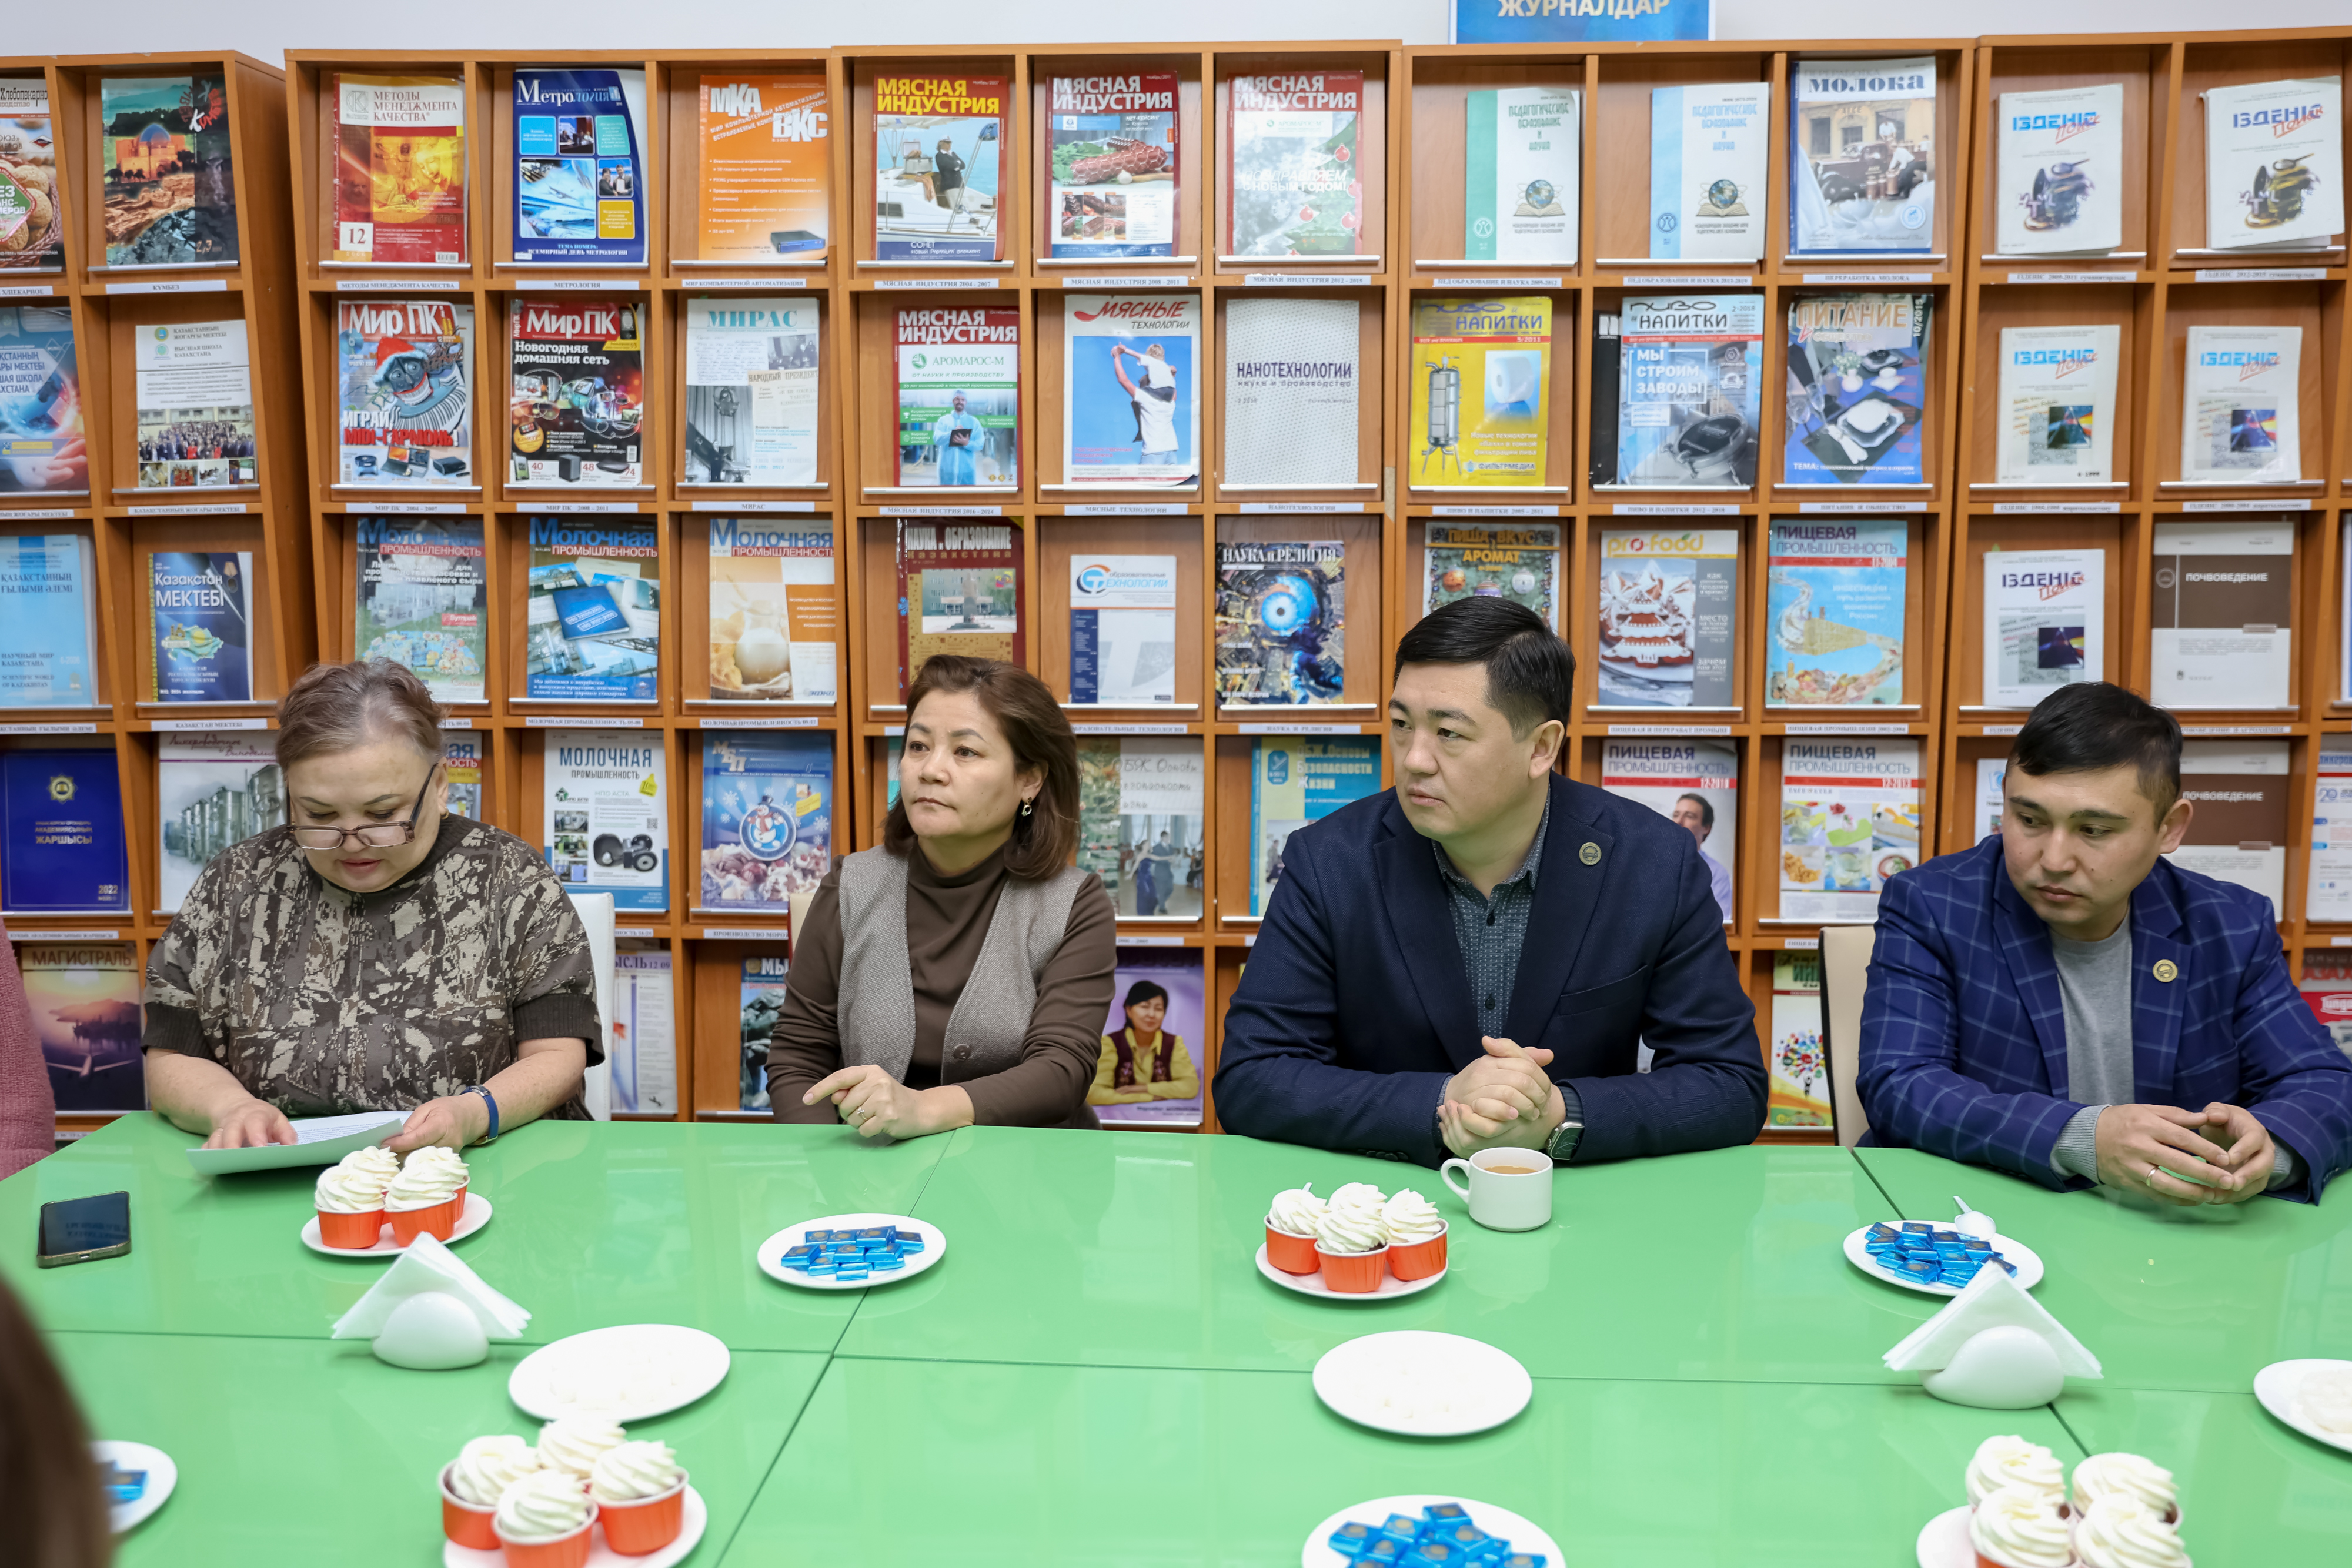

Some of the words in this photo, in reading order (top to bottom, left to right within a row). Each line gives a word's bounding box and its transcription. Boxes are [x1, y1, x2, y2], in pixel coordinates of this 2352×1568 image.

[1498, 0, 1669, 19] ЖУРНАЛДАР
[877, 79, 967, 96] МЯСНАЯ
[1053, 76, 1141, 93] МЯСНАЯ
[1235, 76, 1324, 92] МЯСНАЯ
[375, 91, 420, 101] МЕТОДЫ
[710, 83, 763, 117] МКА
[1053, 92, 1173, 113] ИНДУСТРИЯ
[1235, 92, 1357, 112] ИНДУСТРИЯ
[375, 101, 457, 112] МЕНЕДЖМЕНТА
[710, 125, 723, 133] МИР
[725, 108, 773, 128] КОМПЬЮТЕРНОЙ
[775, 91, 825, 112] АВТОМАТИЗАЦИИ
[877, 95, 999, 115] ИНДУСТРИЯ
[773, 109, 828, 142] ВКС
[1244, 170, 1347, 182] ПОЗДРАВЛЯЕМ
[1242, 182, 1252, 192] С
[1254, 182, 1299, 192] НОВЫМ
[1301, 182, 1347, 192] ГОДОМ!
[348, 228, 366, 245] 12
[1097, 300, 1190, 320] МЯСНЫЕ
[1796, 302, 1909, 329] ПИТАНИЕ
[350, 305, 404, 338] Мир
[410, 304, 443, 335] ПК
[526, 309, 582, 339] Мир
[584, 311, 616, 335] ПК
[707, 310, 798, 328] МИРАС
[899, 310, 985, 326] МЯСНАЯ
[1131, 320, 1190, 330] ТЕХНОЛОГИИ
[1456, 316, 1542, 330] НАПИТКИ
[1639, 314, 1727, 329] НАПИТКИ
[899, 326, 1017, 345] ИНДУСТРИЯ
[514, 340, 589, 354] Новогодняя
[514, 355, 580, 365] домашняя
[583, 356, 610, 365] сеть
[933, 357, 1004, 366] АРОМАРОС-М
[1636, 349, 1664, 362] МЫ
[14, 362, 45, 371] МЕКТЕБІ
[1237, 362, 1352, 379] НАНОТЕХНОЛОГИИ
[1636, 365, 1699, 377] СТРОИМ
[16, 373, 43, 383] ШКОЛА
[749, 372, 781, 382] НАРОДНЫЙ
[1636, 383, 1702, 395] ЗАВОДЫ
[532, 462, 543, 470] 40
[530, 517, 655, 547] Молочная
[710, 519, 833, 548] Молочная
[907, 527, 937, 550] НАУКА
[945, 526, 1012, 550] ОБРАЗОВАНИЕ
[1776, 526, 1856, 541] ПИЩЕВАЯ
[381, 545, 482, 556] ПРОМЫШЛЕННОСТЬ
[552, 545, 658, 557] ПРОМЫШЛЕННОСТЬ
[1776, 541, 1898, 554] ПРОМЫШЛЕННОСТЬ
[1222, 549, 1264, 563] НАУКА
[1267, 552, 1274, 563] и
[1277, 549, 1337, 563] РЕЛИГИЯ
[1462, 550, 1521, 563] АРОМАТ
[155, 571, 223, 586] Қазақстан
[2002, 571, 2083, 588] ІЗДЕНІС
[2186, 572, 2269, 584] ПОЧВОВЕДЕНИЕ
[155, 589, 225, 607] МЕКТЕБІ
[559, 747, 652, 768] МОЛОЧНАЯ
[713, 740, 747, 772] МБП
[1609, 744, 1695, 762] ПИЩЕВАЯ
[1790, 744, 1876, 761] ПИЩЕВАЯ
[1608, 760, 1729, 774] ПРОМЫШЛЕННОСТЬ
[1789, 760, 1910, 775] ПРОМЫШЛЕННОСТЬ
[572, 770, 640, 780] ПРОМЫШЛЕННОСТЬ
[2182, 791, 2264, 802] ПОЧВОВЕДЕНИЕ
[36, 835, 92, 845] ЖАРШЫСЫ
[98, 884, 118, 894] 2022
[32, 950, 132, 967] МАГИСТРАЛЬ
